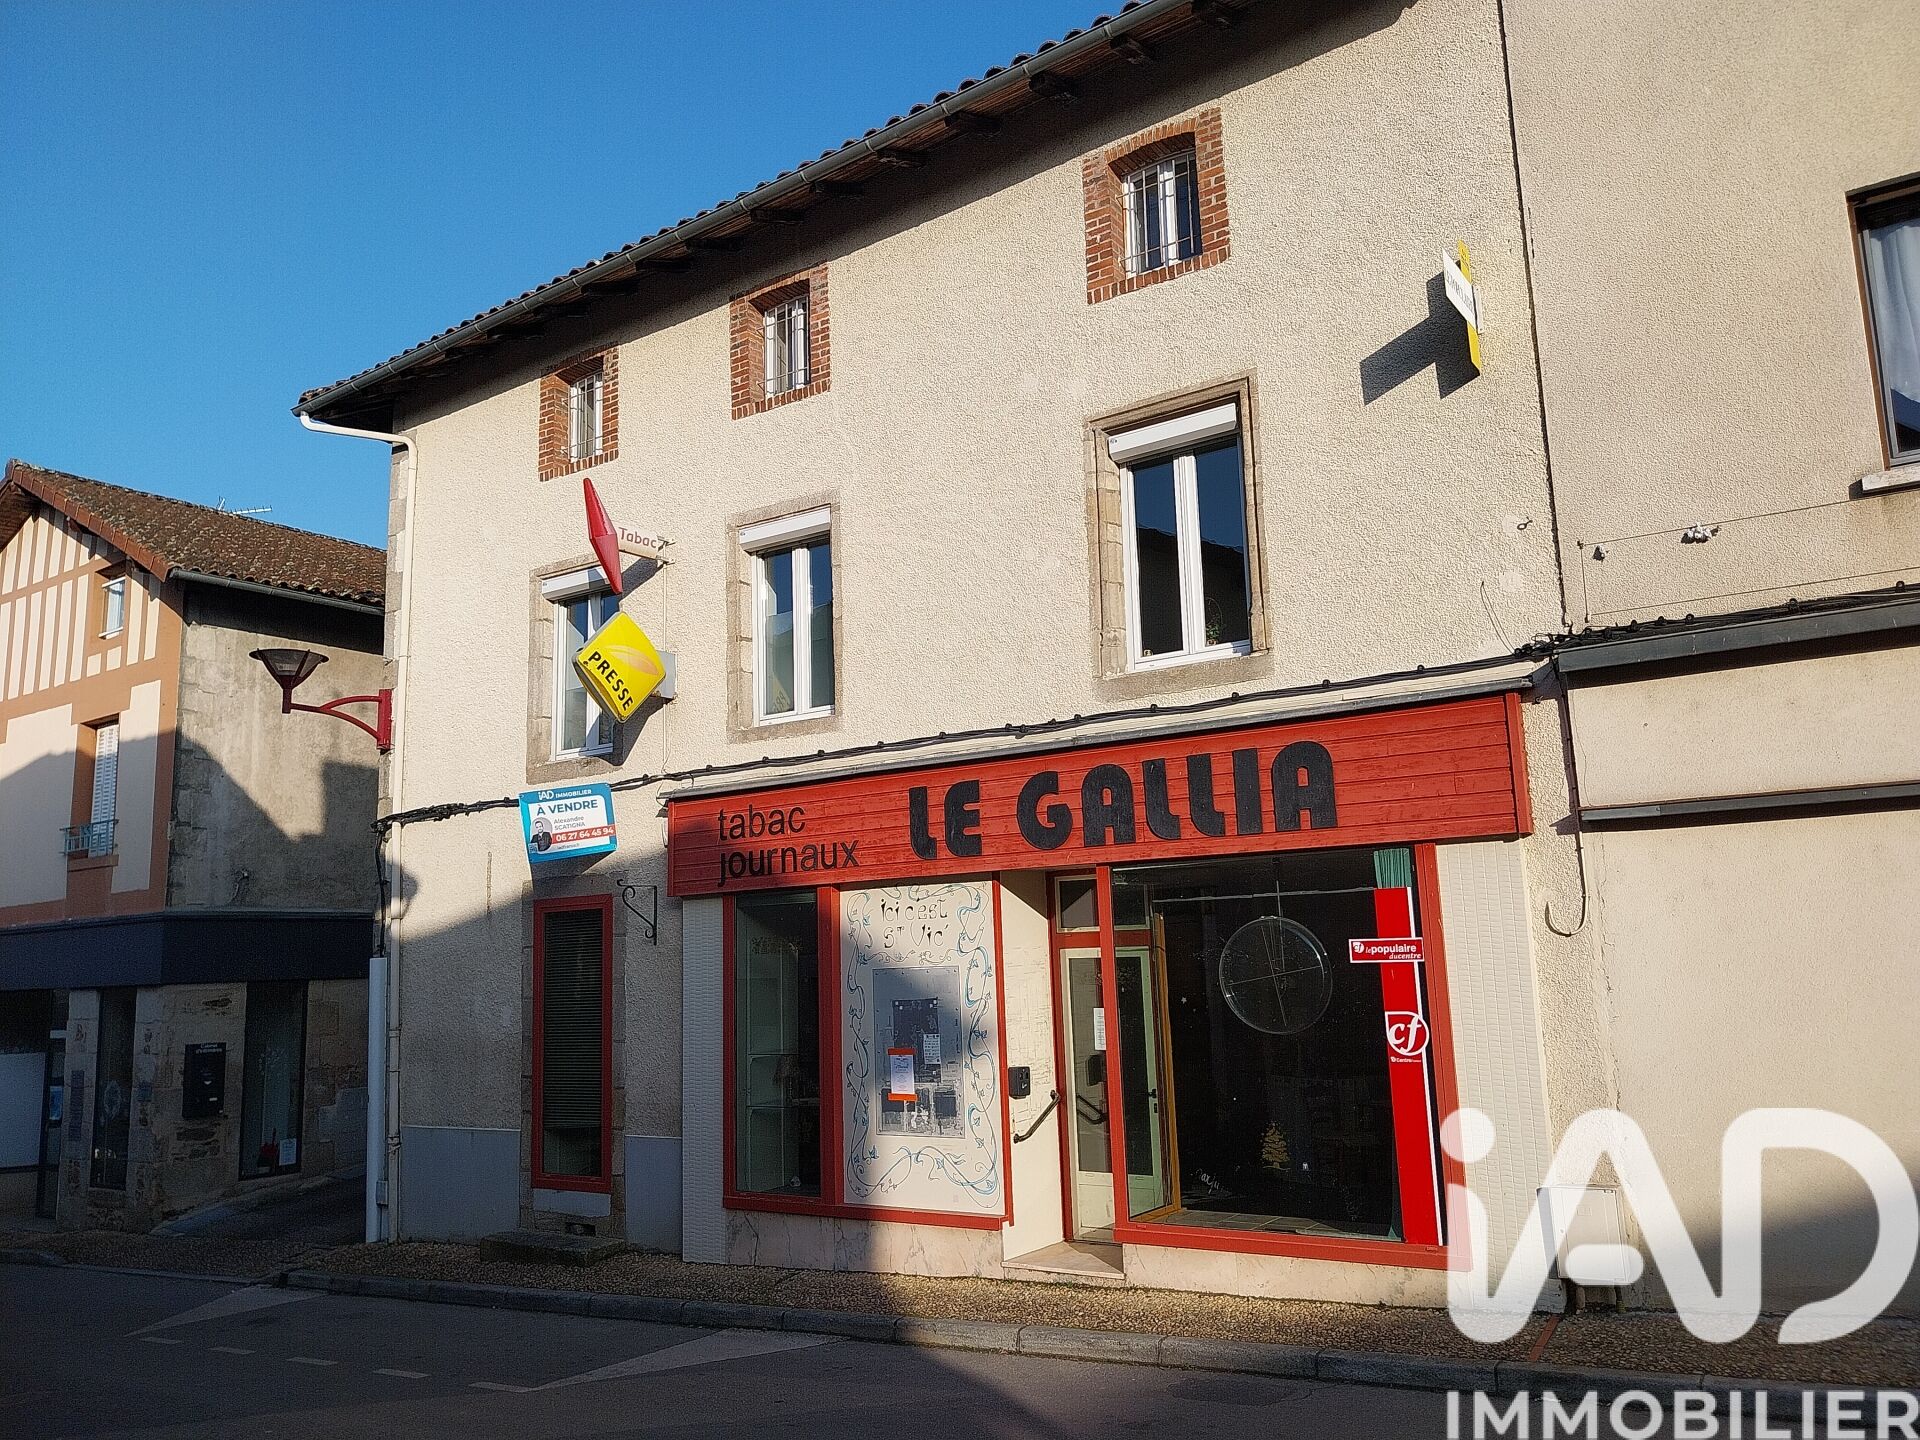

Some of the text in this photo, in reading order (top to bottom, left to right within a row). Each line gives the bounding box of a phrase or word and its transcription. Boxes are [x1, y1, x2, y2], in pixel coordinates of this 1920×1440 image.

[619, 526, 657, 549] Tabac
[588, 651, 634, 711] PRESSE
[537, 799, 599, 816] À VENDRE
[555, 789, 592, 798] IMMOBILIER
[908, 741, 1338, 860] LE GALLIA
[556, 833, 567, 842] 06
[568, 832, 578, 840] 27
[718, 804, 806, 841] tabac
[717, 839, 860, 888] journaux
